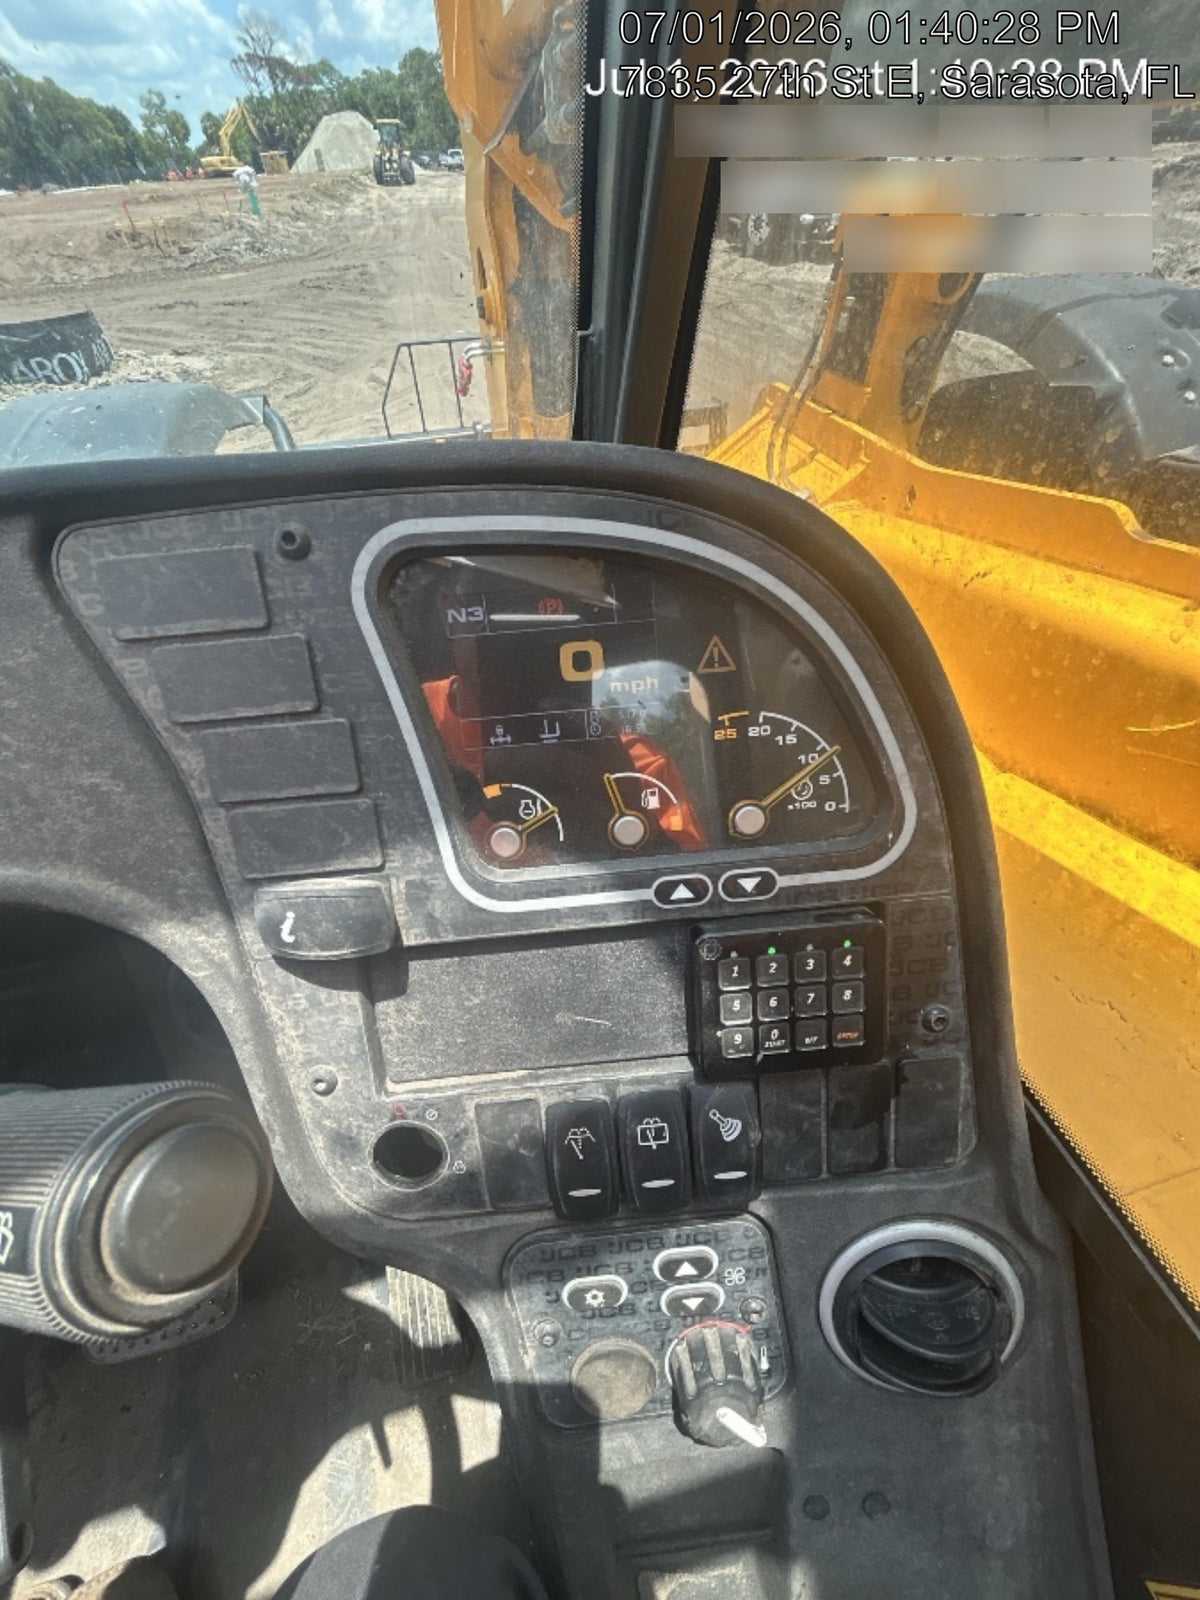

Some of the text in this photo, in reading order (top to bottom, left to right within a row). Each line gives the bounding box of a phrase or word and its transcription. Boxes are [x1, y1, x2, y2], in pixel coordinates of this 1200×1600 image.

[447, 606, 484, 623] N3
[610, 677, 659, 694] mph
[714, 728, 737, 740] 25
[748, 725, 771, 737] 20
[775, 734, 797, 745] 15
[797, 753, 819, 764] 10
[819, 775, 830, 785] 5
[824, 801, 836, 811] 0
[731, 954, 853, 977] 1 2 3 4
[733, 989, 853, 1011] 5 6 7 8
[733, 1029, 779, 1045] 9 0
